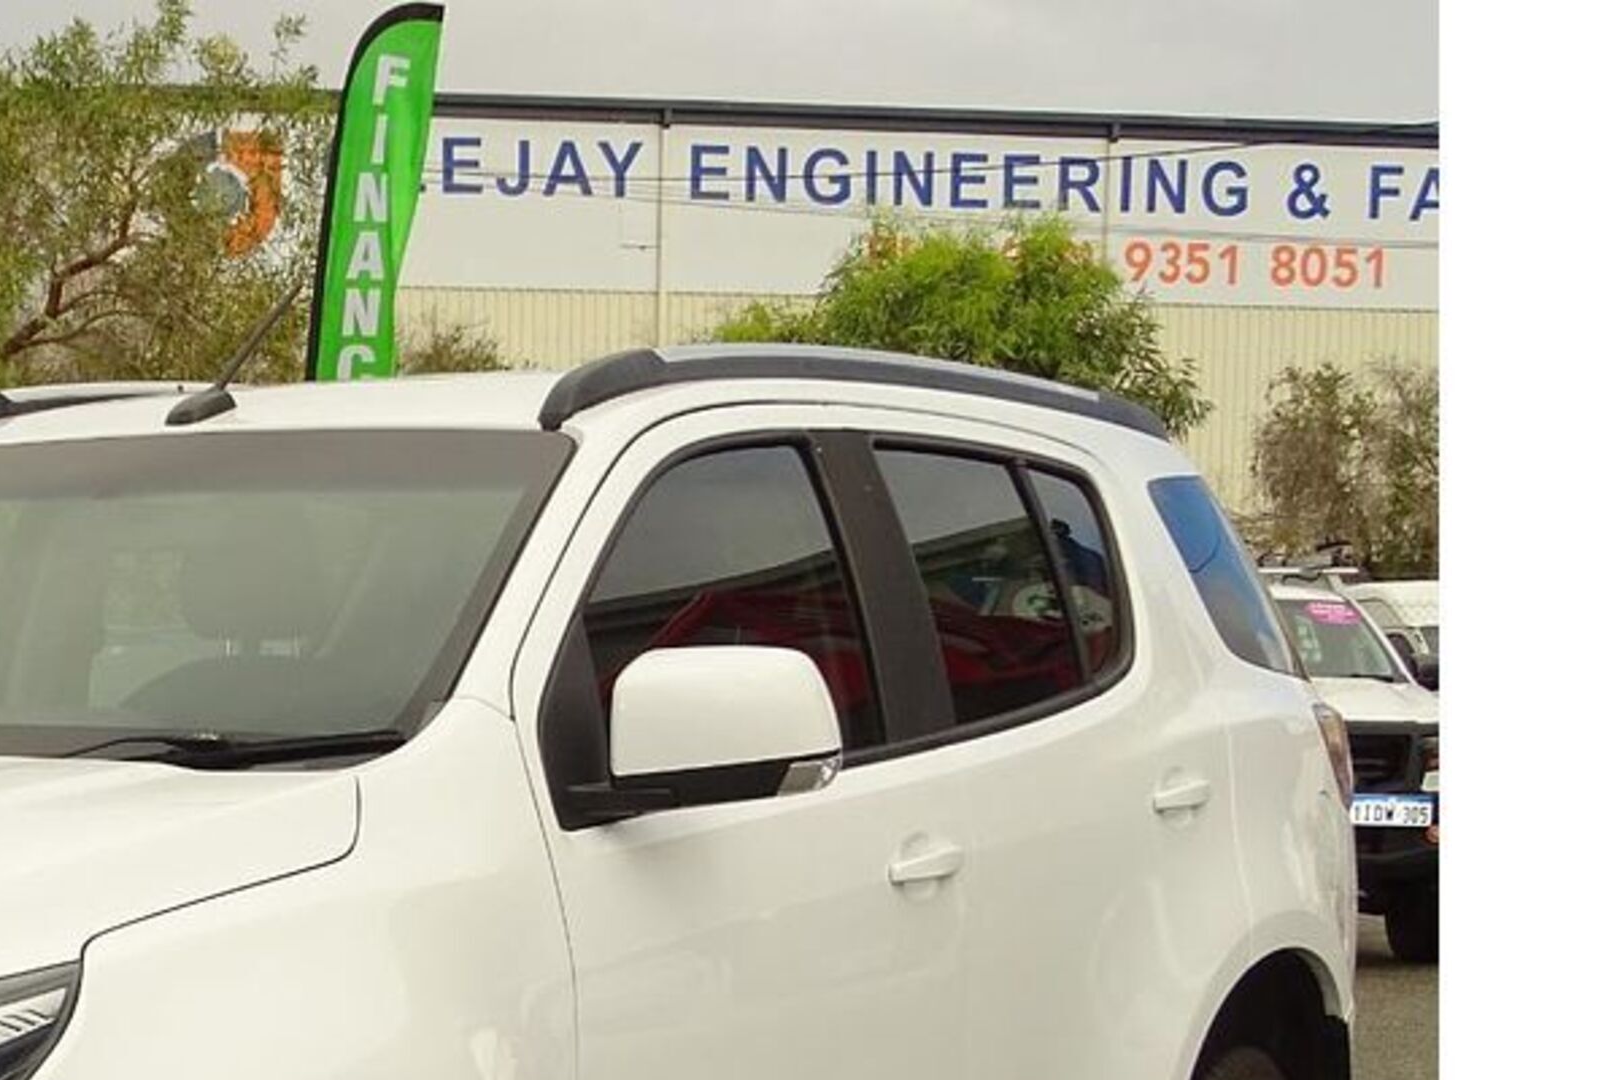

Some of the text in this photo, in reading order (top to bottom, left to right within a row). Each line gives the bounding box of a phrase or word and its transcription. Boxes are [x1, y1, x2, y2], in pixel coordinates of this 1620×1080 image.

[337, 54, 411, 381] FINANC
[420, 135, 643, 198] EJAY
[690, 144, 1249, 217] ENGINEERING
[1286, 163, 1331, 220] &
[1124, 240, 1240, 285] 9351
[1270, 244, 1387, 288] 8051
